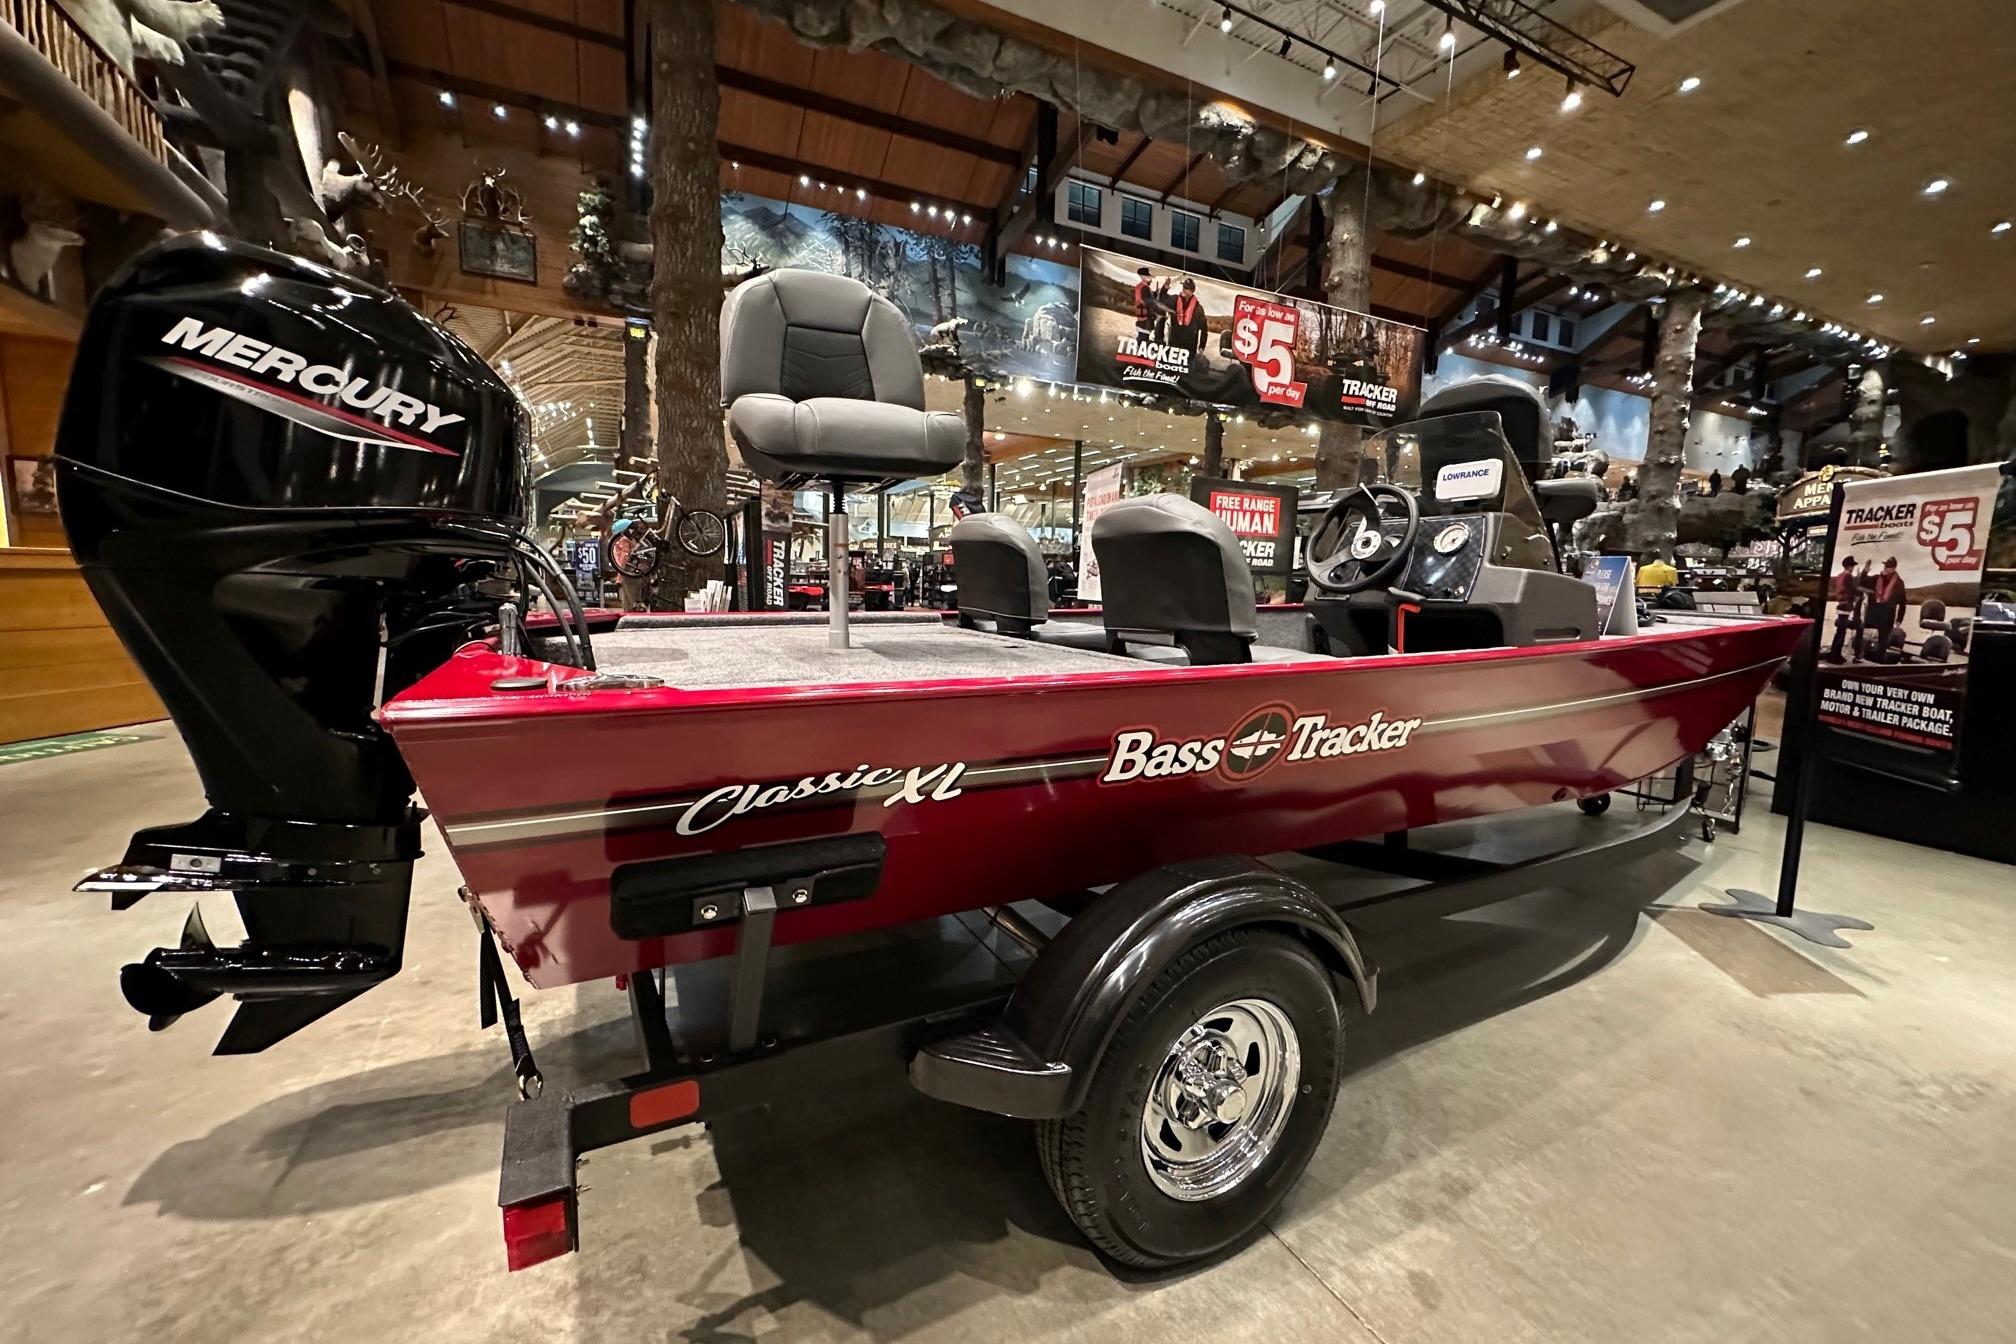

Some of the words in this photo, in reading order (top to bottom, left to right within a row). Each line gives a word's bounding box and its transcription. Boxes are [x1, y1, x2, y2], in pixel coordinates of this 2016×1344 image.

[1239, 300, 1254, 312] For
[1255, 307, 1266, 316] as
[1268, 307, 1283, 319] low
[1285, 313, 1295, 322] as
[1117, 335, 1190, 366] TRACKER
[1234, 314, 1294, 393] $5
[161, 317, 465, 434] MERCURY
[1155, 360, 1189, 374] boats
[1267, 386, 1285, 396] per
[1286, 387, 1301, 400] day
[1342, 379, 1398, 403] TRACKER
[1365, 399, 1376, 408] OFF
[1377, 402, 1396, 411] ROAD
[1442, 468, 1490, 481] LOWRANCE
[1804, 481, 1834, 497] MEN
[1216, 496, 1240, 510] FREE
[1243, 498, 1275, 512] RANGE
[1793, 494, 1832, 510] APPA
[1846, 503, 1917, 524] TRACKER
[1880, 520, 1914, 529] boats
[1919, 510, 1974, 564] $5
[578, 547, 596, 564] $50
[1239, 540, 1275, 557] CKER
[1252, 558, 1274, 567] ROAD
[773, 540, 786, 607] TRACKER
[1842, 679, 1859, 691] OWN
[1861, 682, 1884, 695] YOUR
[1887, 687, 1909, 699] VERY
[1911, 691, 1935, 704] OWN
[1823, 688, 1854, 702] BRAND
[1855, 694, 1874, 707] NEW
[1876, 698, 1920, 716] TRACKER
[1922, 707, 1953, 724] BOAT,
[1820, 700, 1850, 715] MOTOR
[1853, 706, 1860, 717] &
[1862, 708, 1899, 726] TRAILER
[1901, 716, 1953, 737] PACKAGE.
[1103, 731, 1225, 782] Bass
[1287, 711, 1422, 761] Tracker
[676, 764, 902, 836] Classic
[883, 762, 966, 808] XL
